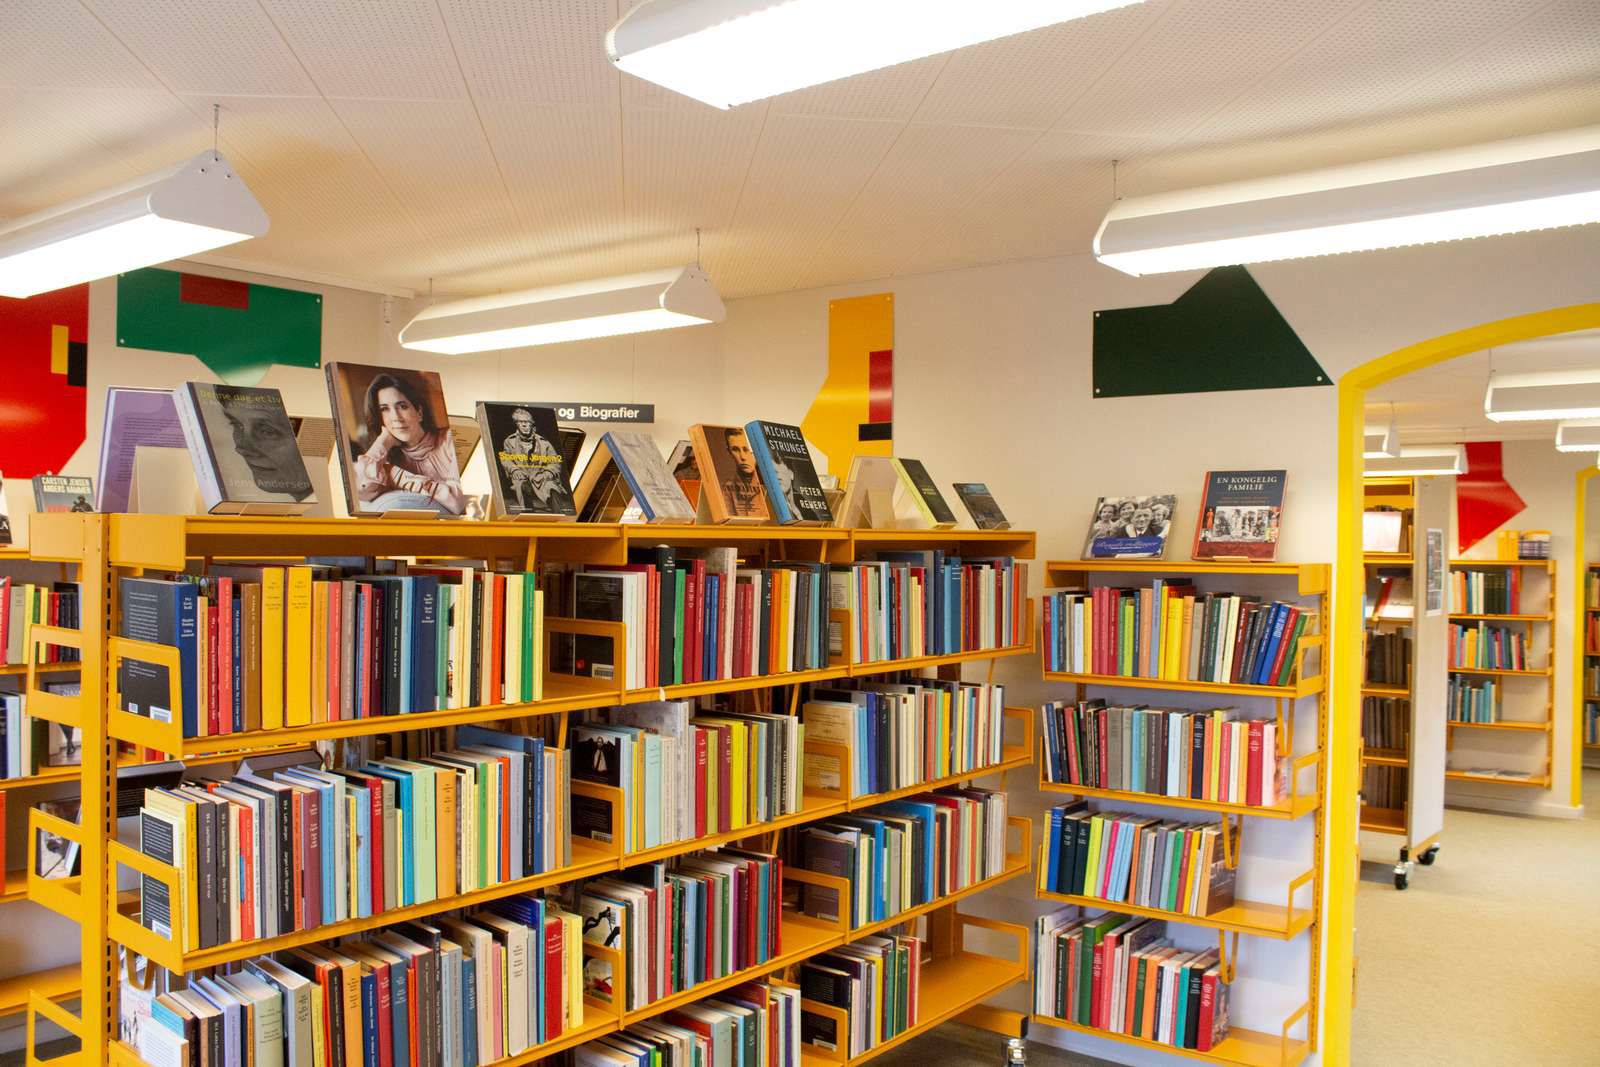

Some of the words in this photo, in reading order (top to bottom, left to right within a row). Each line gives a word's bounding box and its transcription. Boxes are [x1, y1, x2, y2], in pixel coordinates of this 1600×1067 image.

[558, 408, 576, 419] og
[580, 406, 640, 420] Biografier
[763, 425, 803, 441] MICHAEL
[768, 439, 808, 455] STRUNGE
[256, 479, 311, 490] Andersen
[1231, 476, 1278, 484] KONGELIG
[799, 486, 823, 496] PETER
[799, 499, 828, 510] REWERS
